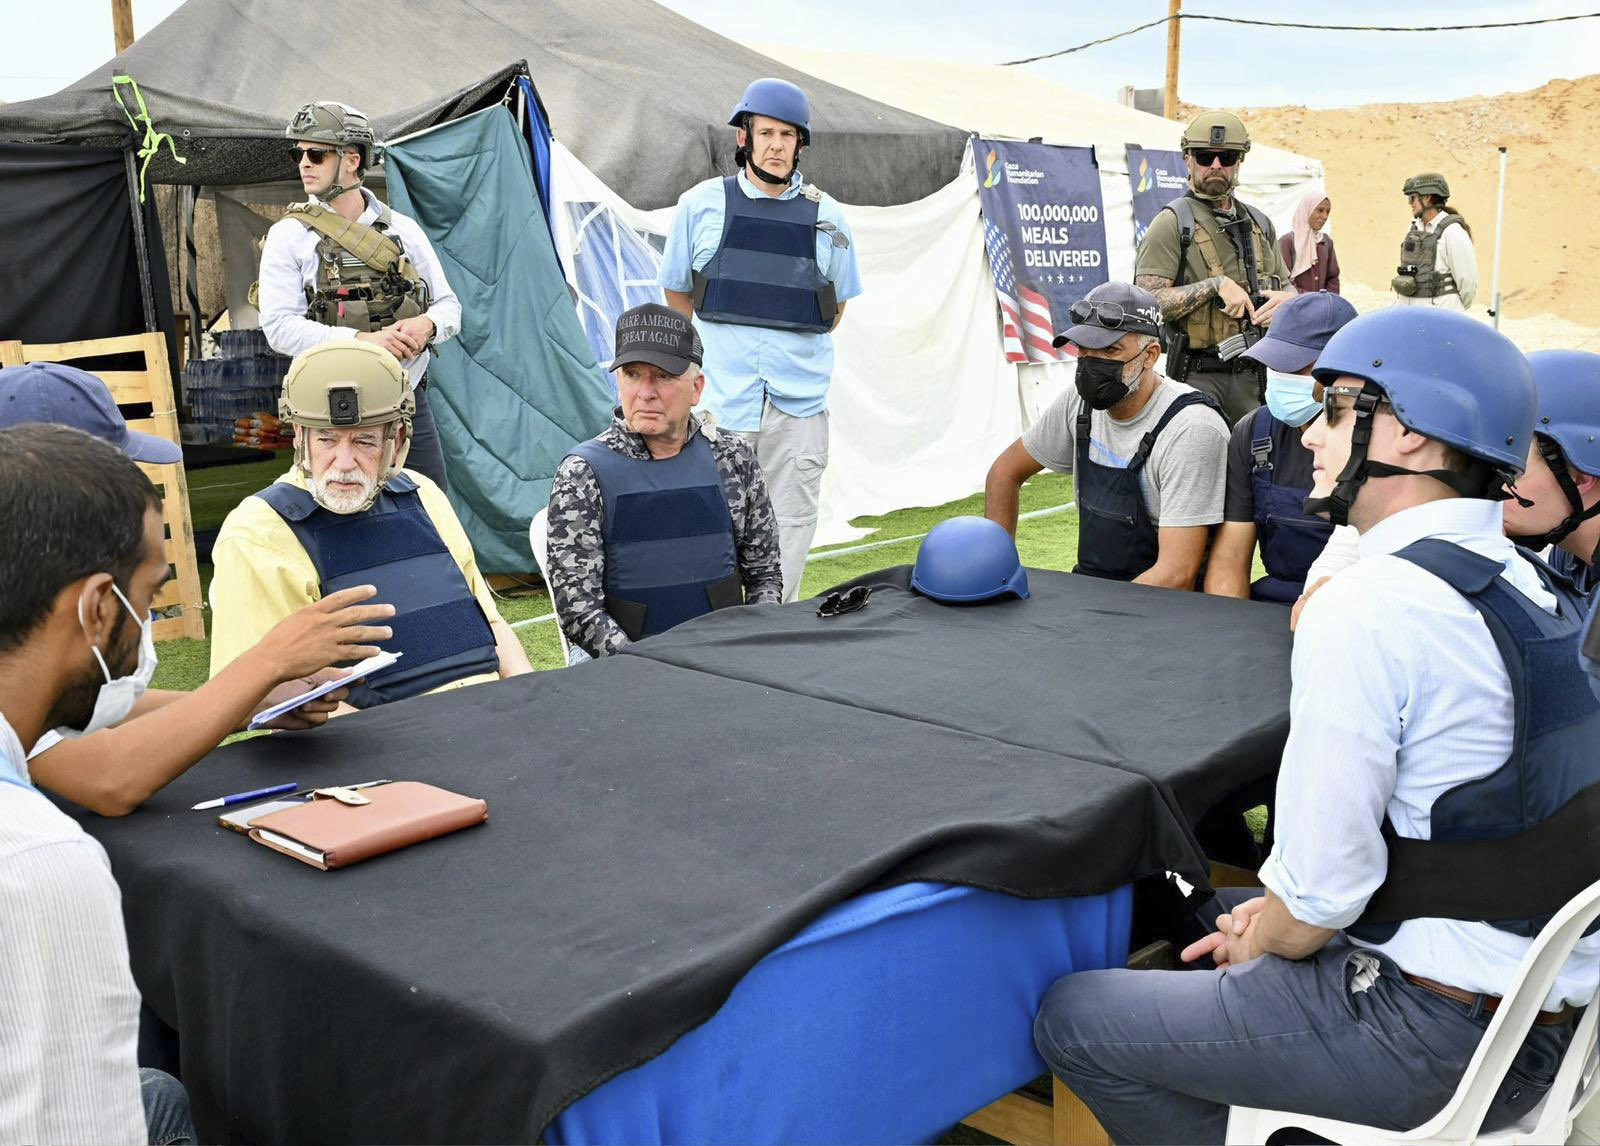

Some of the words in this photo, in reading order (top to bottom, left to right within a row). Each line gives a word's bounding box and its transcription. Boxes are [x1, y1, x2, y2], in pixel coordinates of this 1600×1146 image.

[1004, 161, 1019, 170] Gaza
[1006, 169, 1045, 178] Humanitarian
[1007, 177, 1039, 185] Foundation
[1017, 203, 1098, 225] 100,000,000
[1021, 226, 1069, 245] MEALS
[1024, 249, 1101, 267] DELIVERED
[618, 314, 640, 330] MAKE
[640, 314, 687, 333] AMERICA
[622, 330, 648, 346] GREAT
[648, 331, 681, 348] AGAIN
